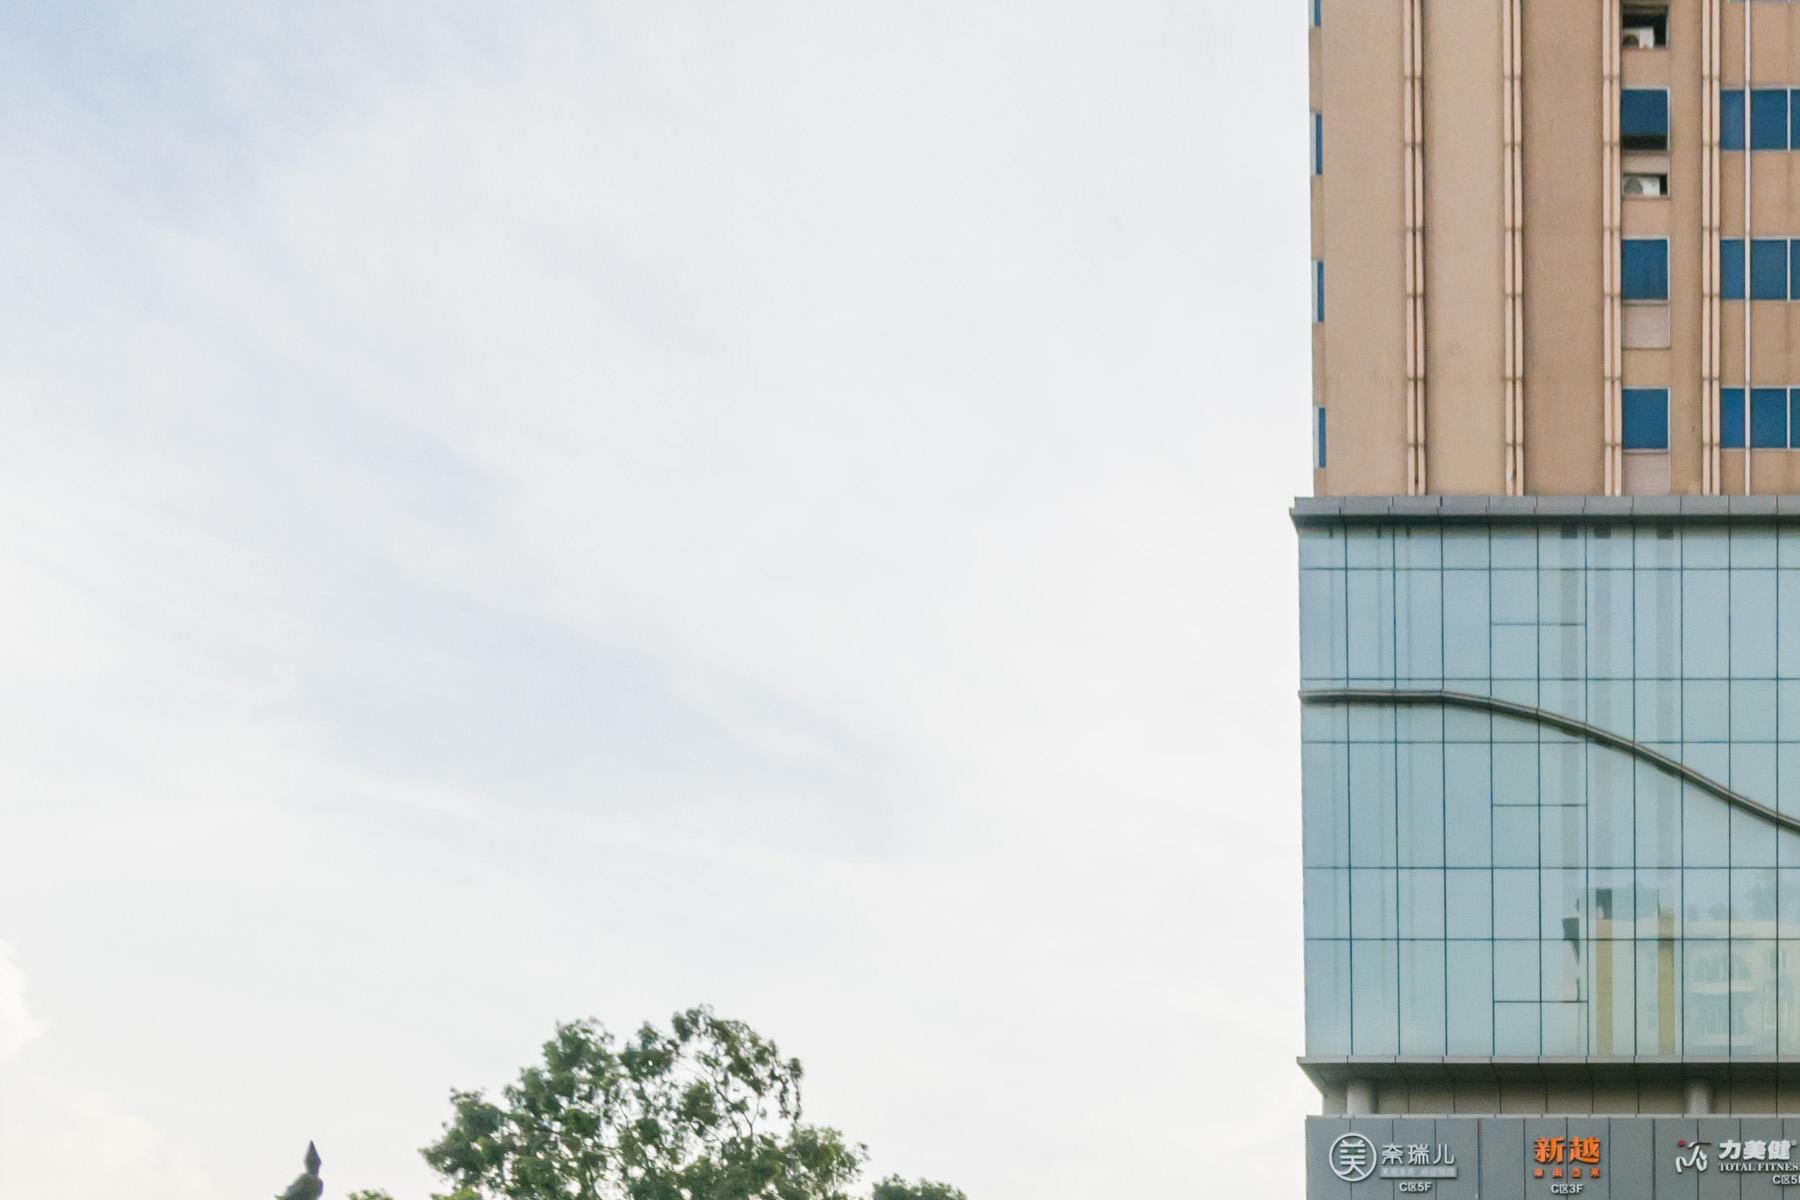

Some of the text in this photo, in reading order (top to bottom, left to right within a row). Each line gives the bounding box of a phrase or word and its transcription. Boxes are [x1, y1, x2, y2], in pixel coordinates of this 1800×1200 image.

[1535, 1136, 1600, 1164] 新越
[1718, 1140, 1792, 1160] 力美健
[1719, 1163, 1755, 1172] TOTAL
[1399, 1181, 1432, 1192] C区5F
[1550, 1184, 1584, 1194] C区3F
